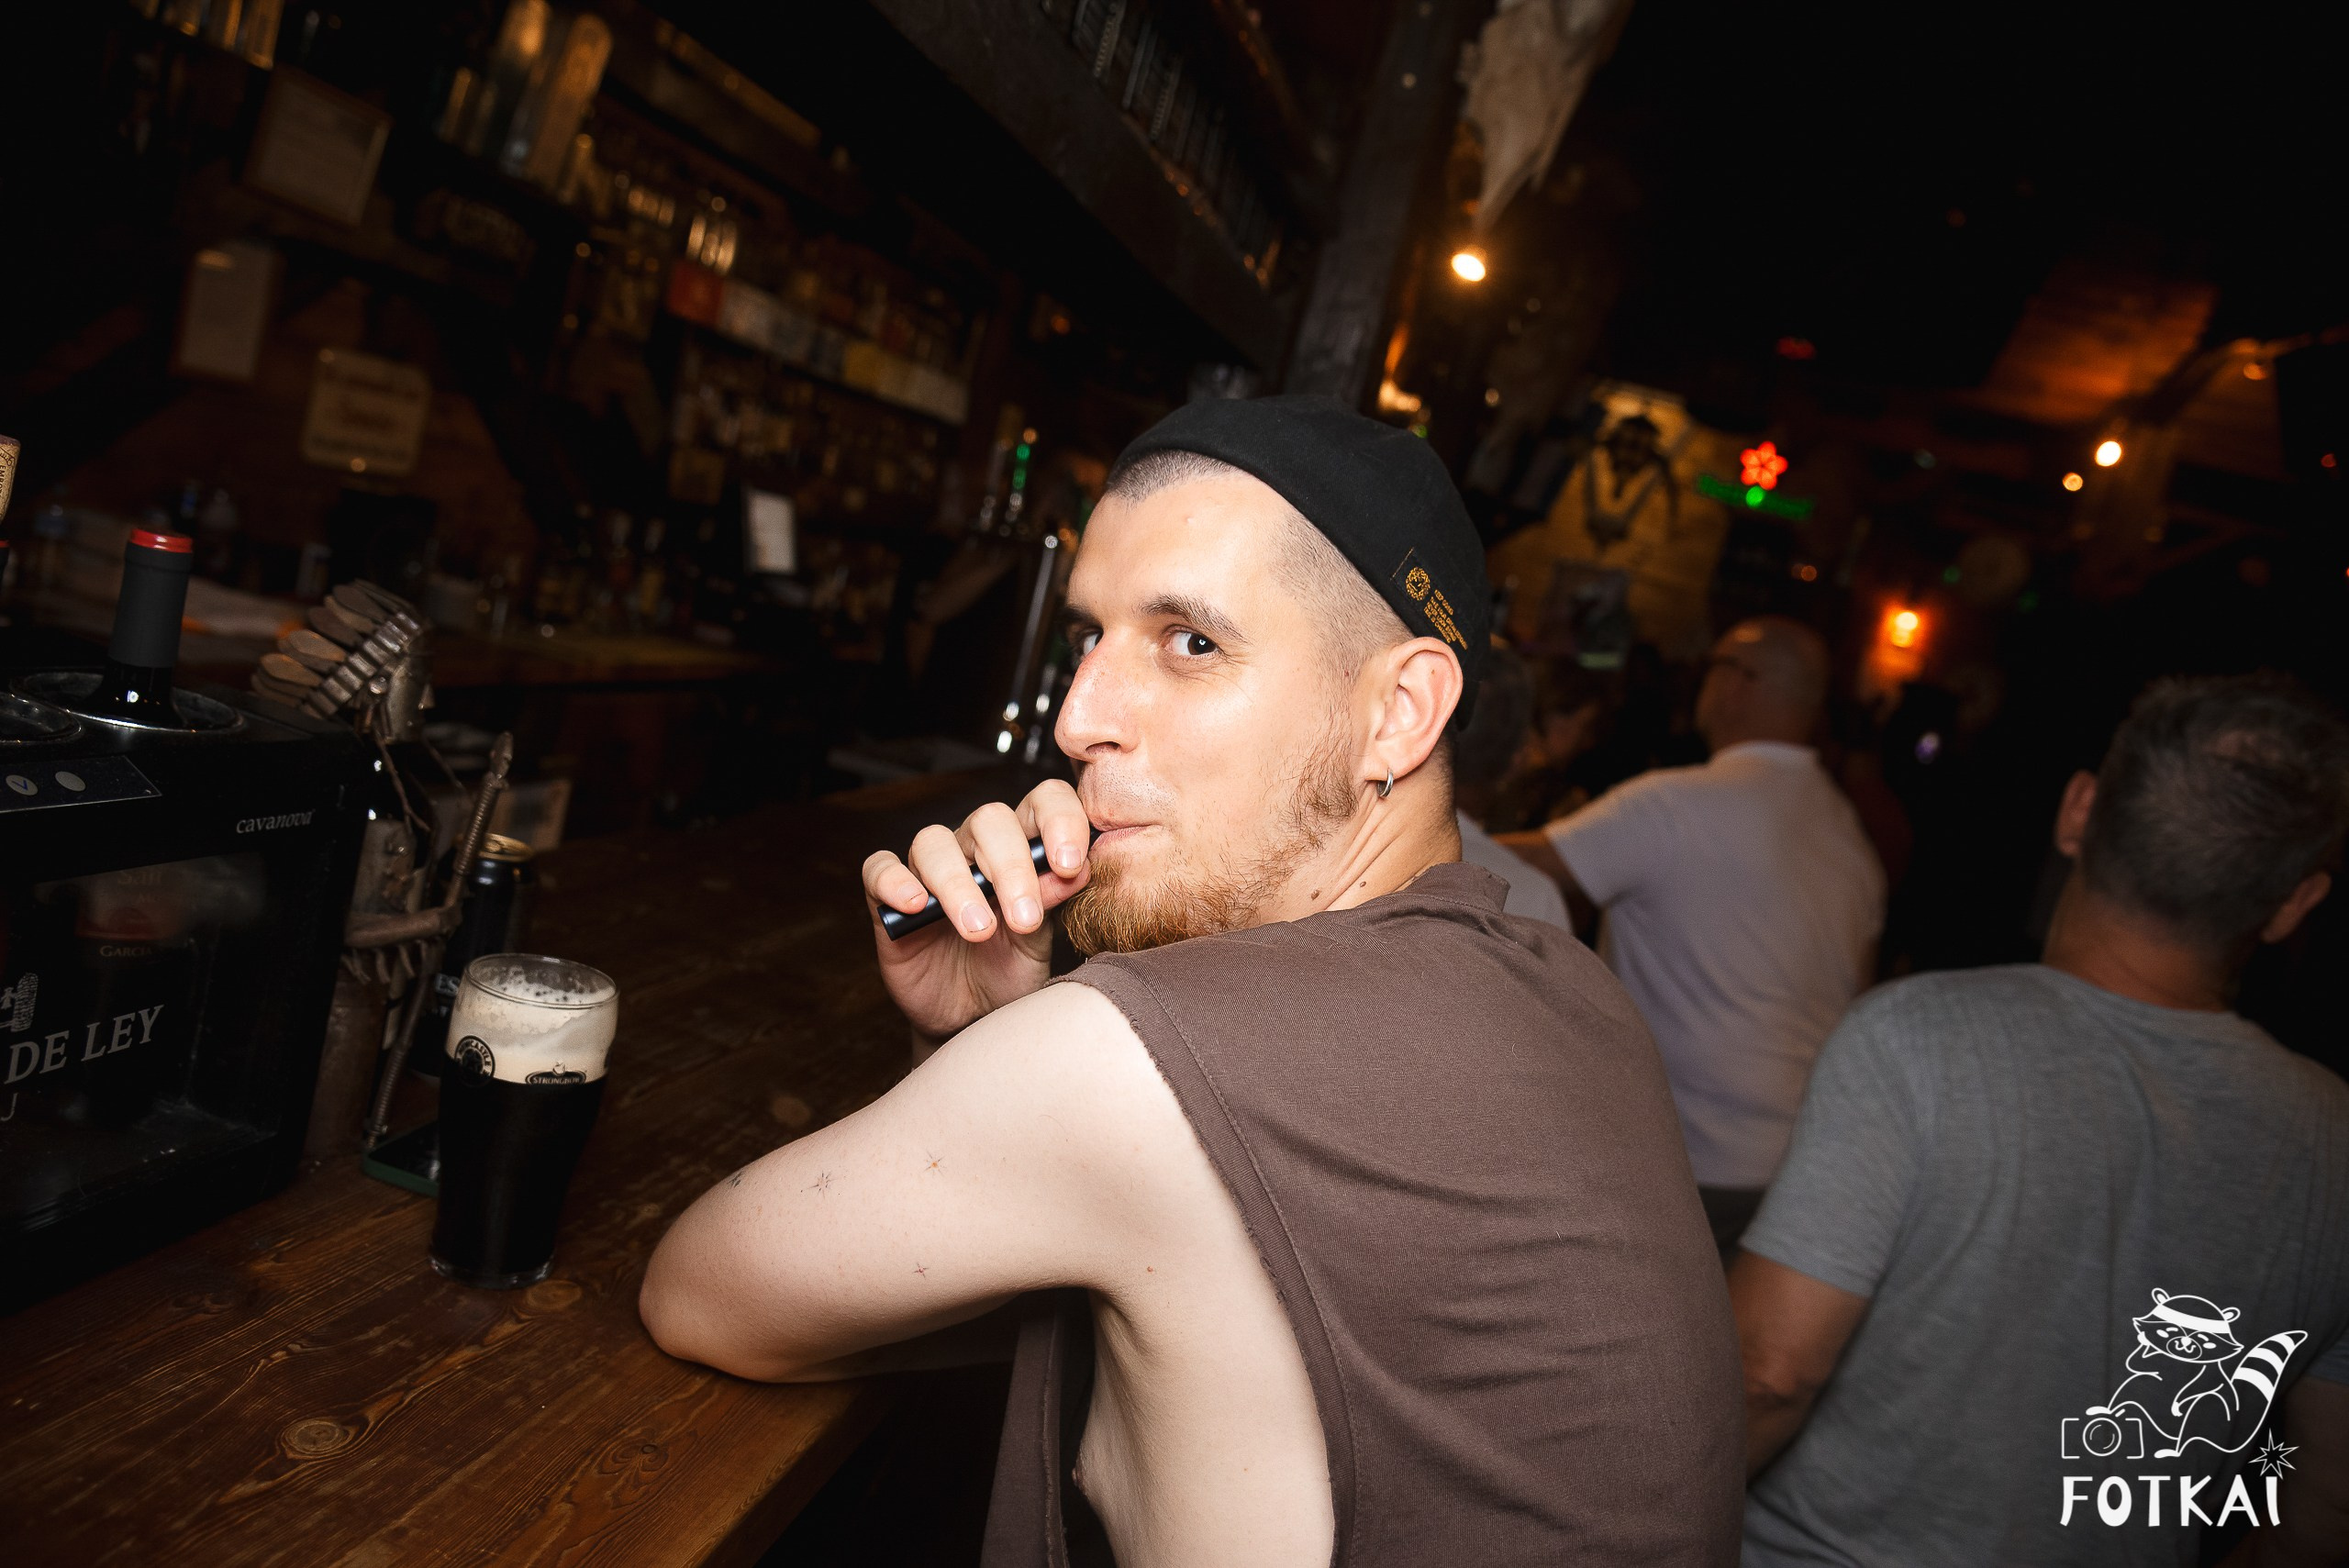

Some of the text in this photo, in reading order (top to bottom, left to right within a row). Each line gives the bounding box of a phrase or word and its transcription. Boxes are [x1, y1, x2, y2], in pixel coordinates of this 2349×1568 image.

[236, 812, 312, 834] cavanova
[4, 1004, 165, 1084] DE LEY
